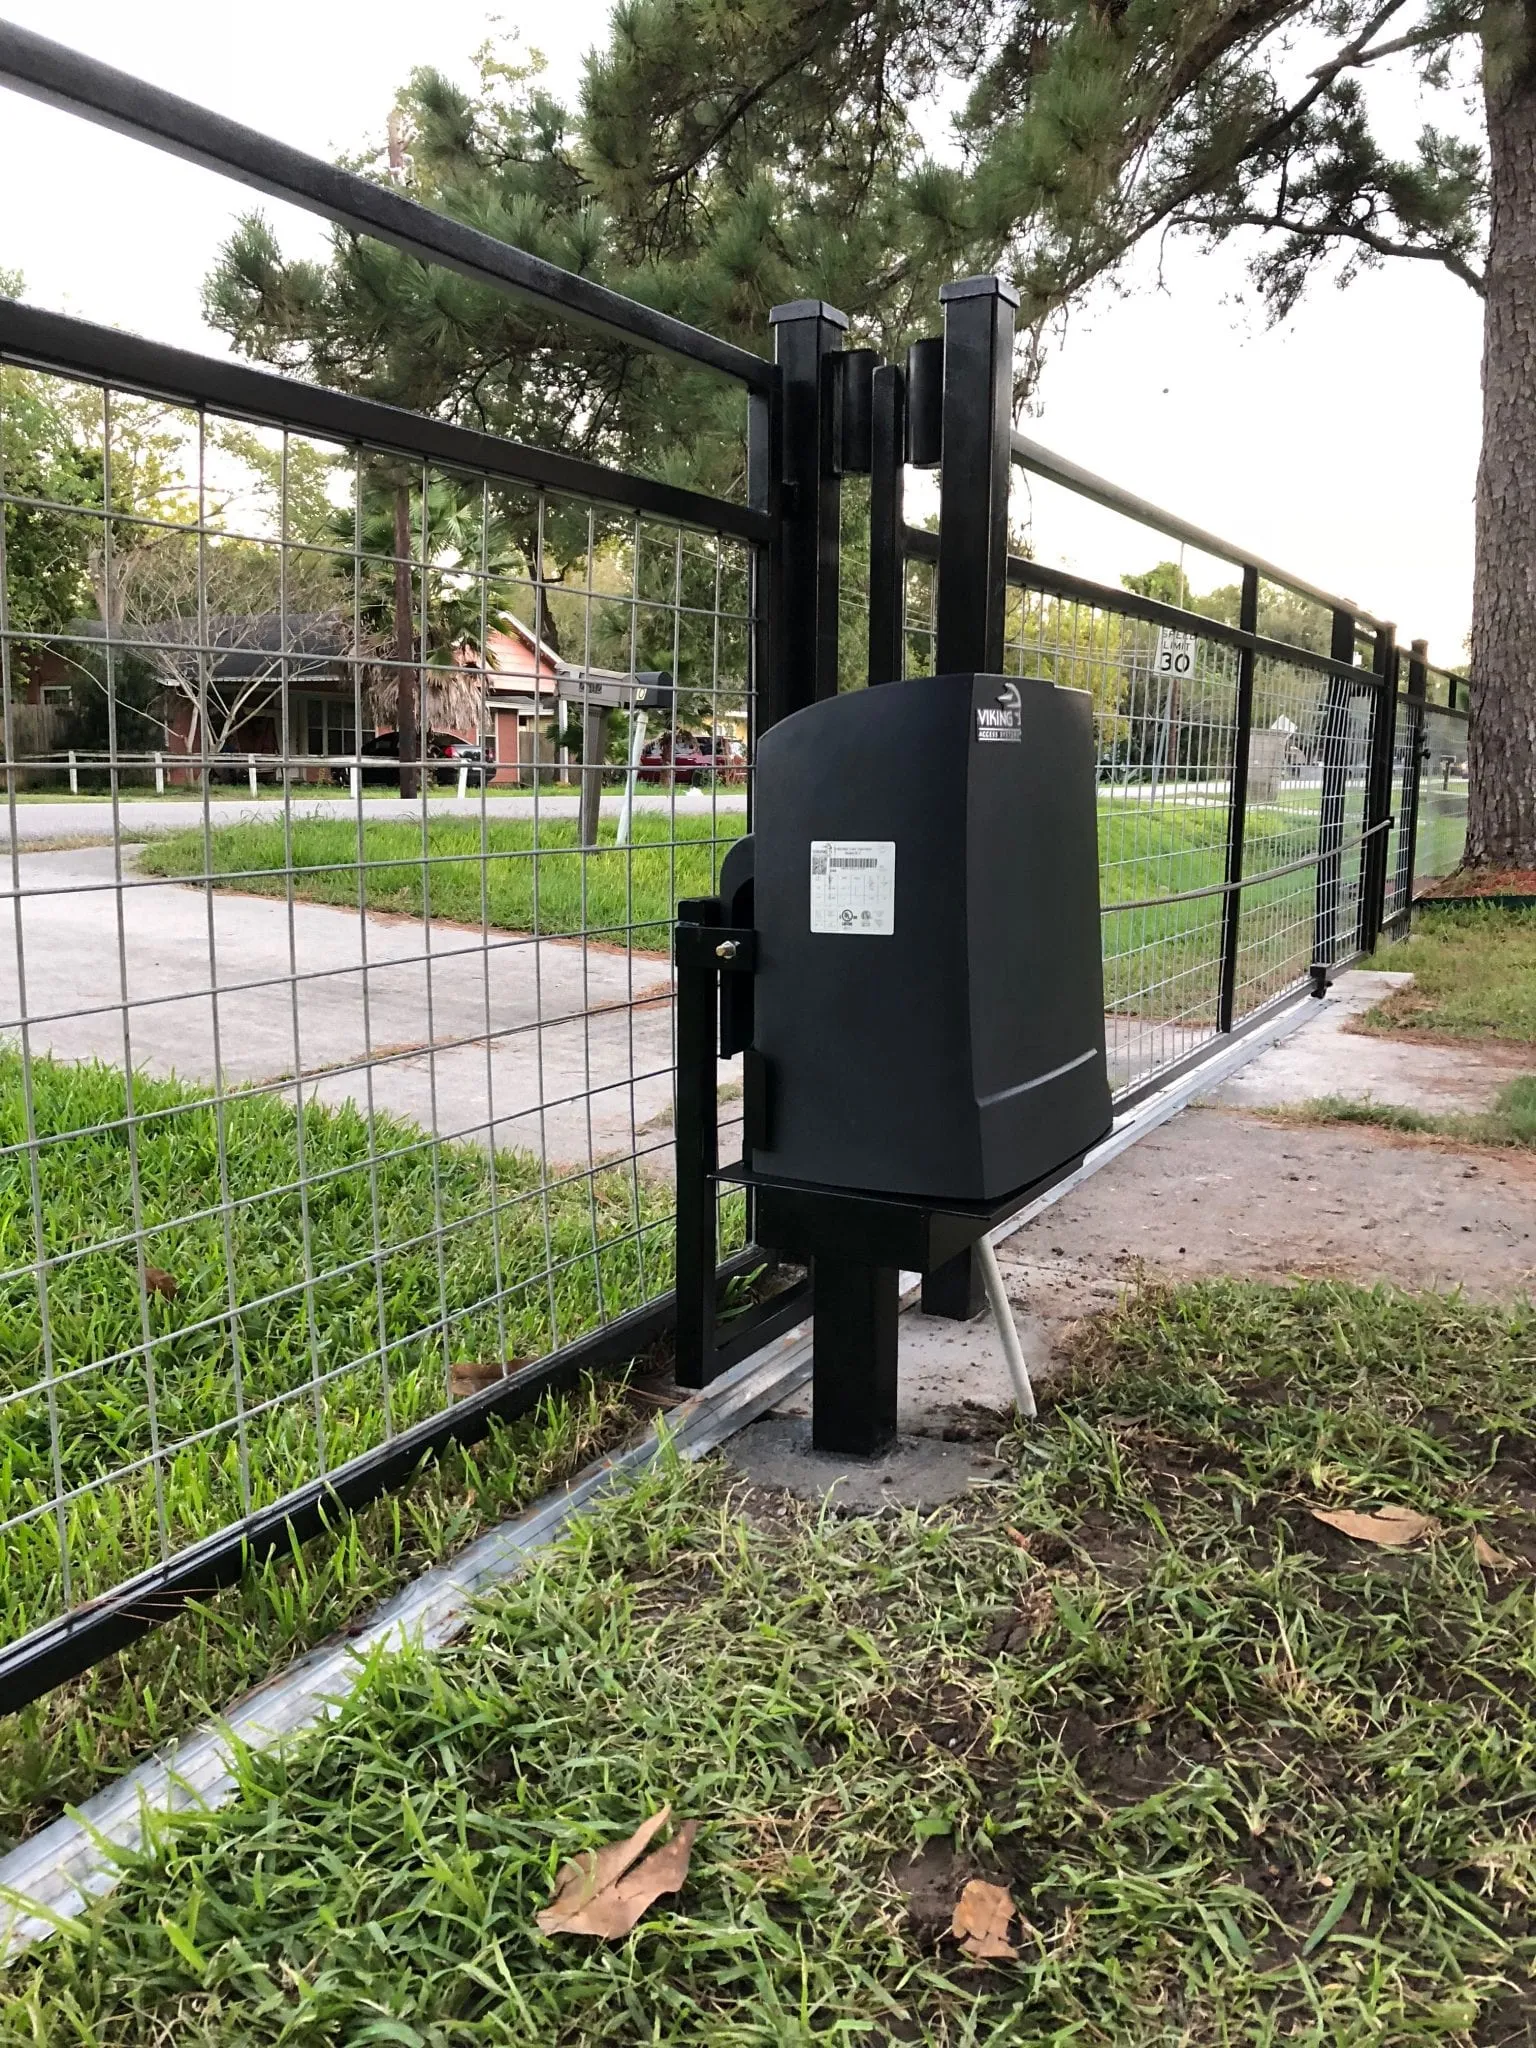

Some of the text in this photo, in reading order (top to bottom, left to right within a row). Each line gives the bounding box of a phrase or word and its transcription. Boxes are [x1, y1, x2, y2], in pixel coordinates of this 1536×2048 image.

[1162, 628, 1196, 640] SPEED
[1163, 640, 1190, 651] LIMIT
[1161, 652, 1190, 673] 30
[977, 708, 1013, 726] VIKING
[978, 730, 999, 738] ACCESS
